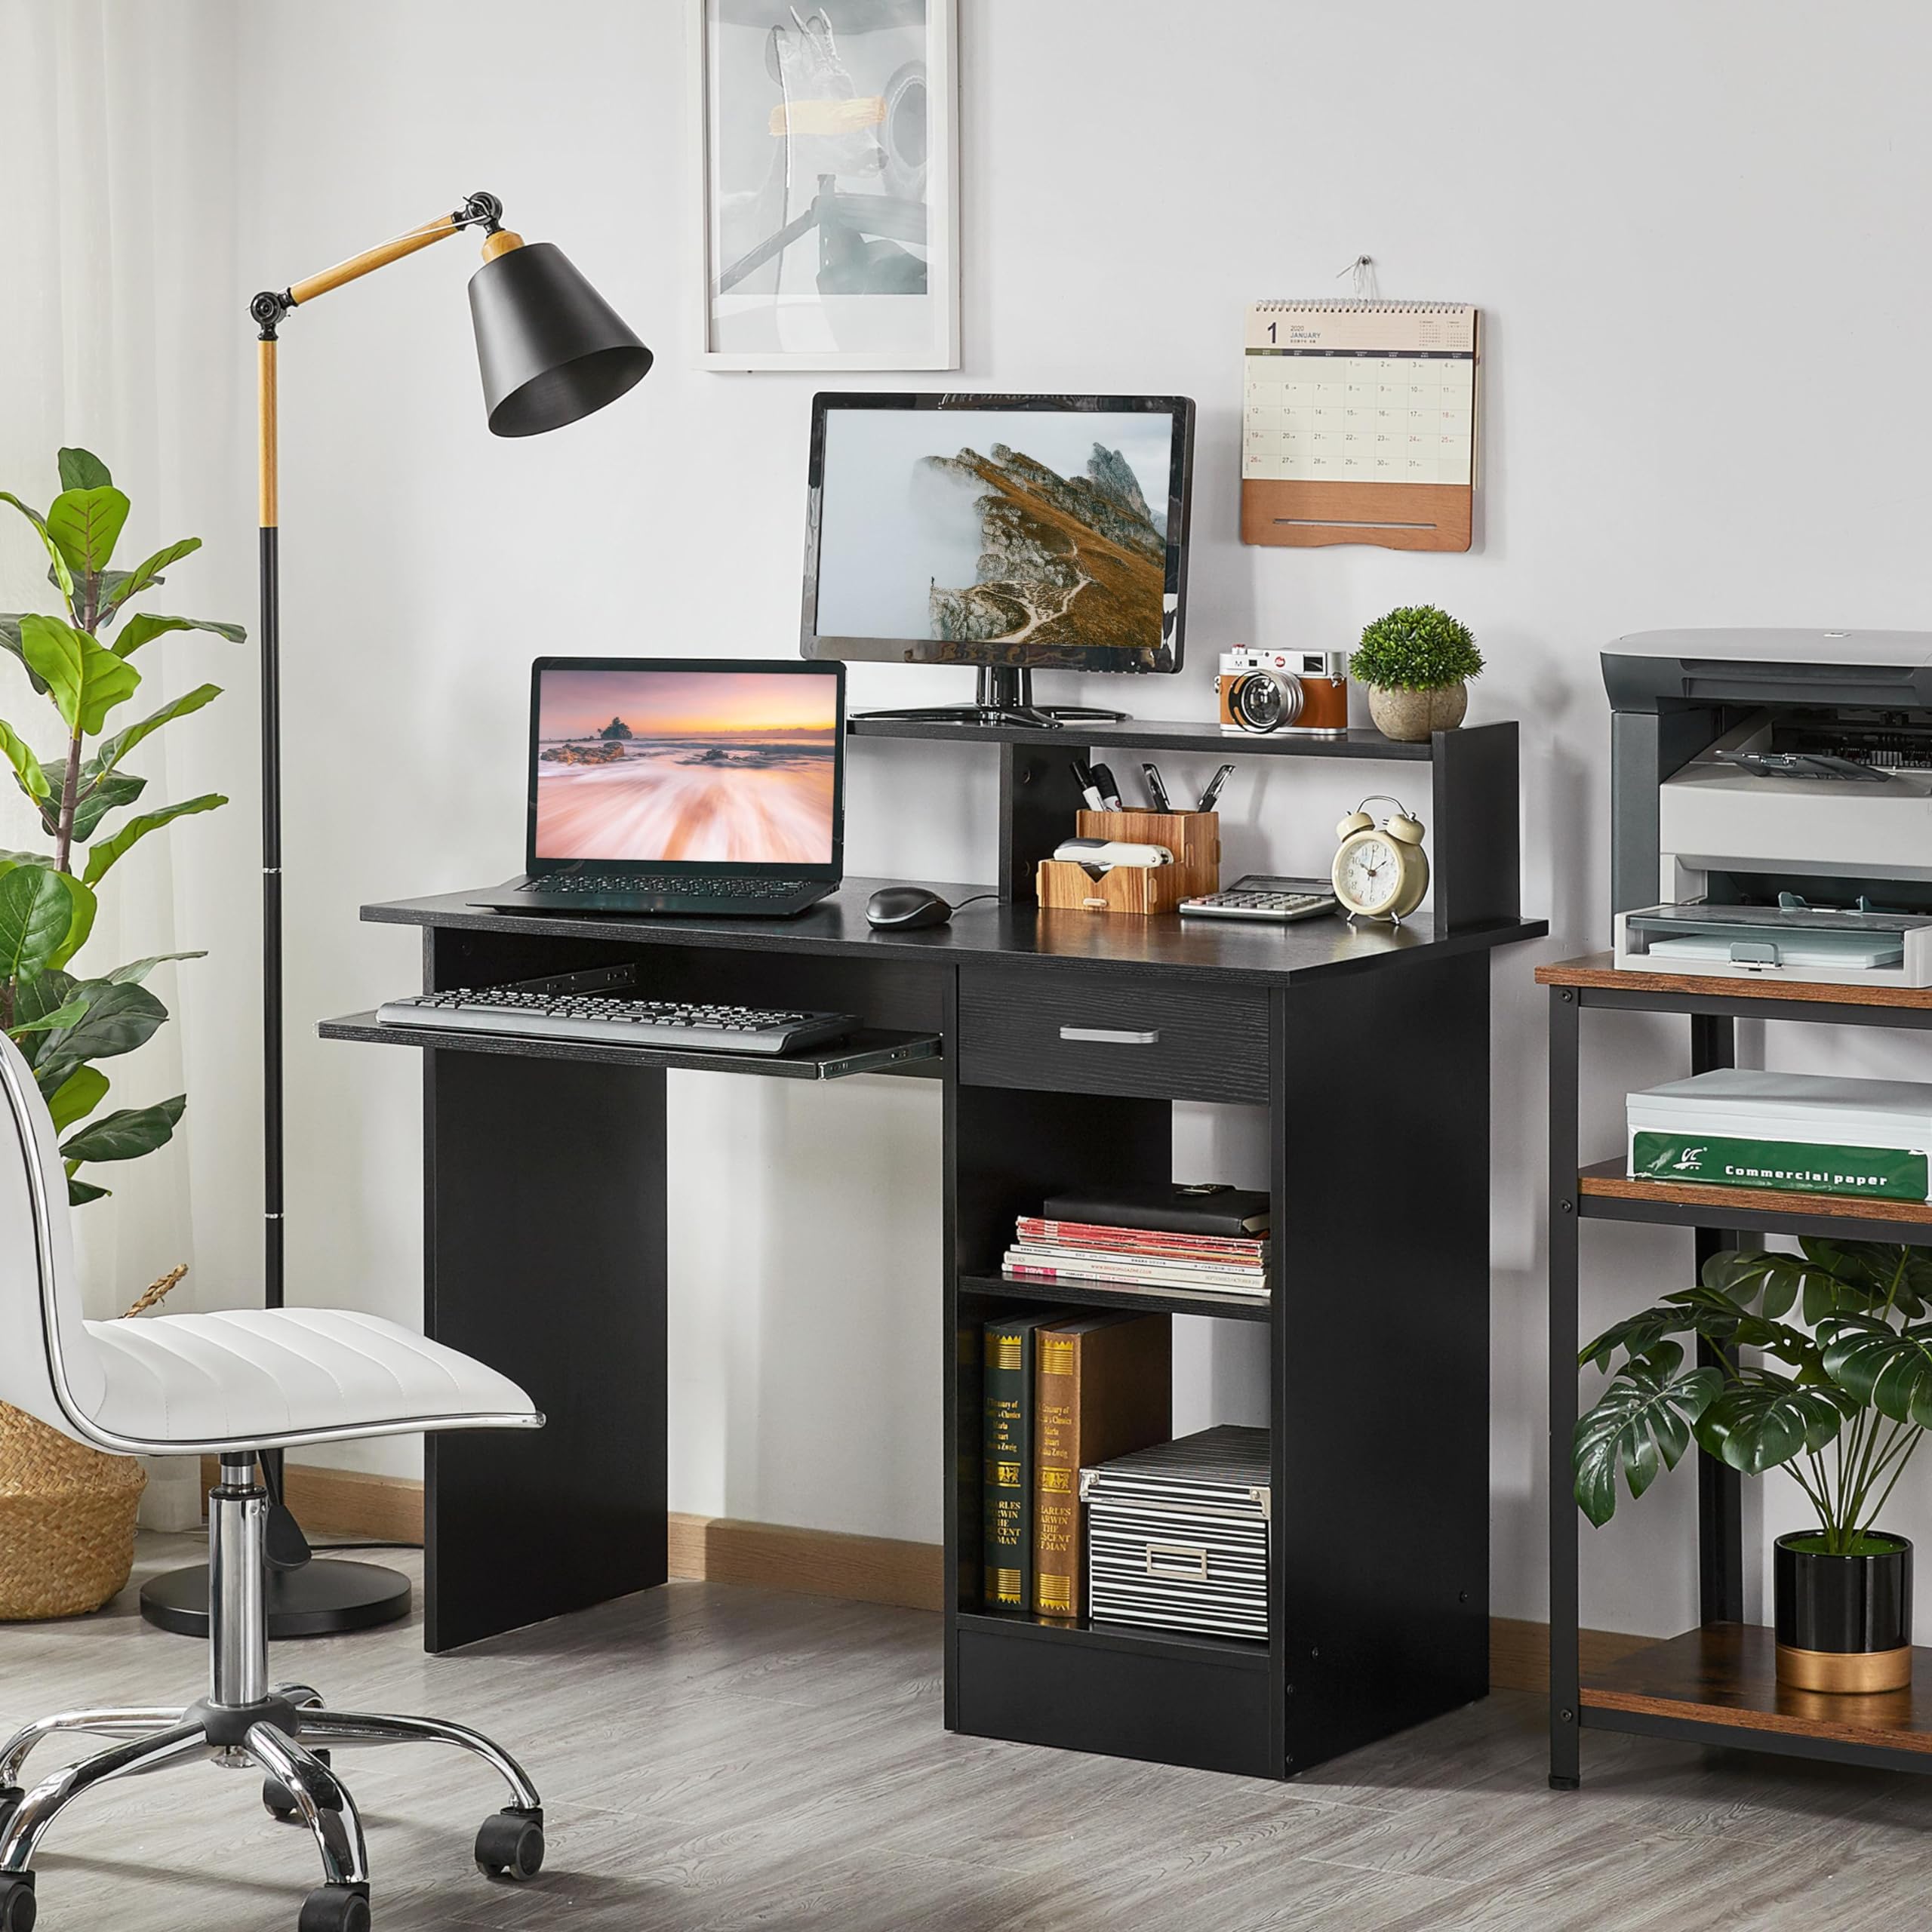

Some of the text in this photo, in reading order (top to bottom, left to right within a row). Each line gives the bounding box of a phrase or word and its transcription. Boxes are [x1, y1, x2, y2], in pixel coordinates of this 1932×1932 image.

[1268, 322, 1276, 343] 1
[1725, 1165, 1887, 1186] Commercial paper
[1041, 1515, 1068, 1524] ARWIN
